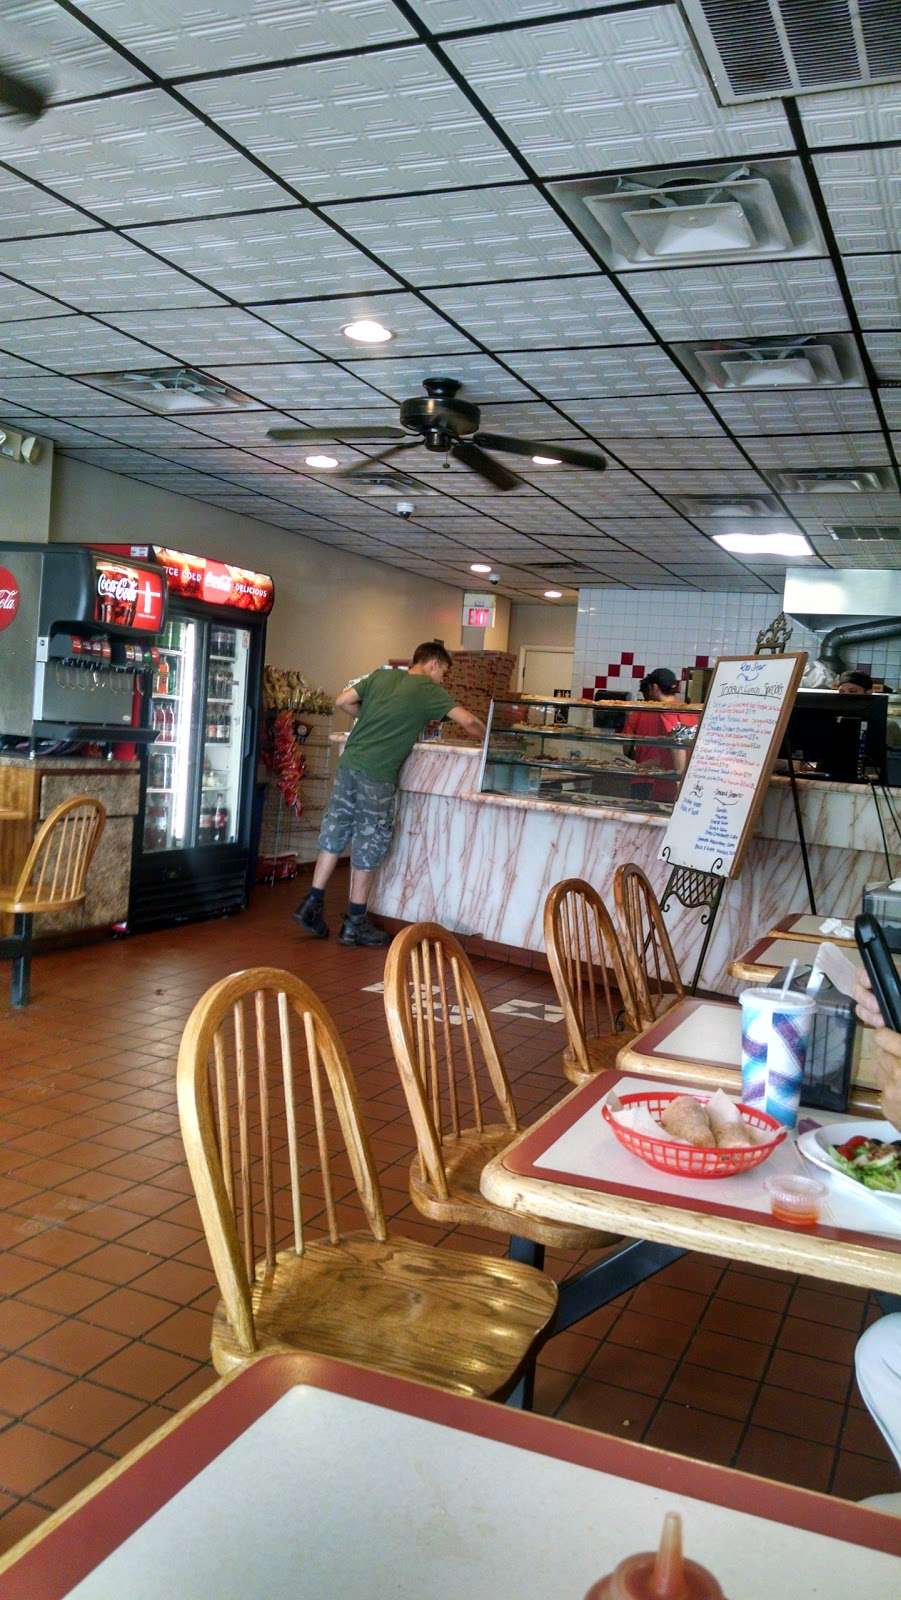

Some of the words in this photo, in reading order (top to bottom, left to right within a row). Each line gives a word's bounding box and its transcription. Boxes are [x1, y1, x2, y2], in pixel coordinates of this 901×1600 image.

[97, 573, 138, 602] Coca-Cola
[181, 570, 202, 582] COLD
[235, 584, 268, 598] DELICIOUS
[468, 608, 489, 625] EXIT
